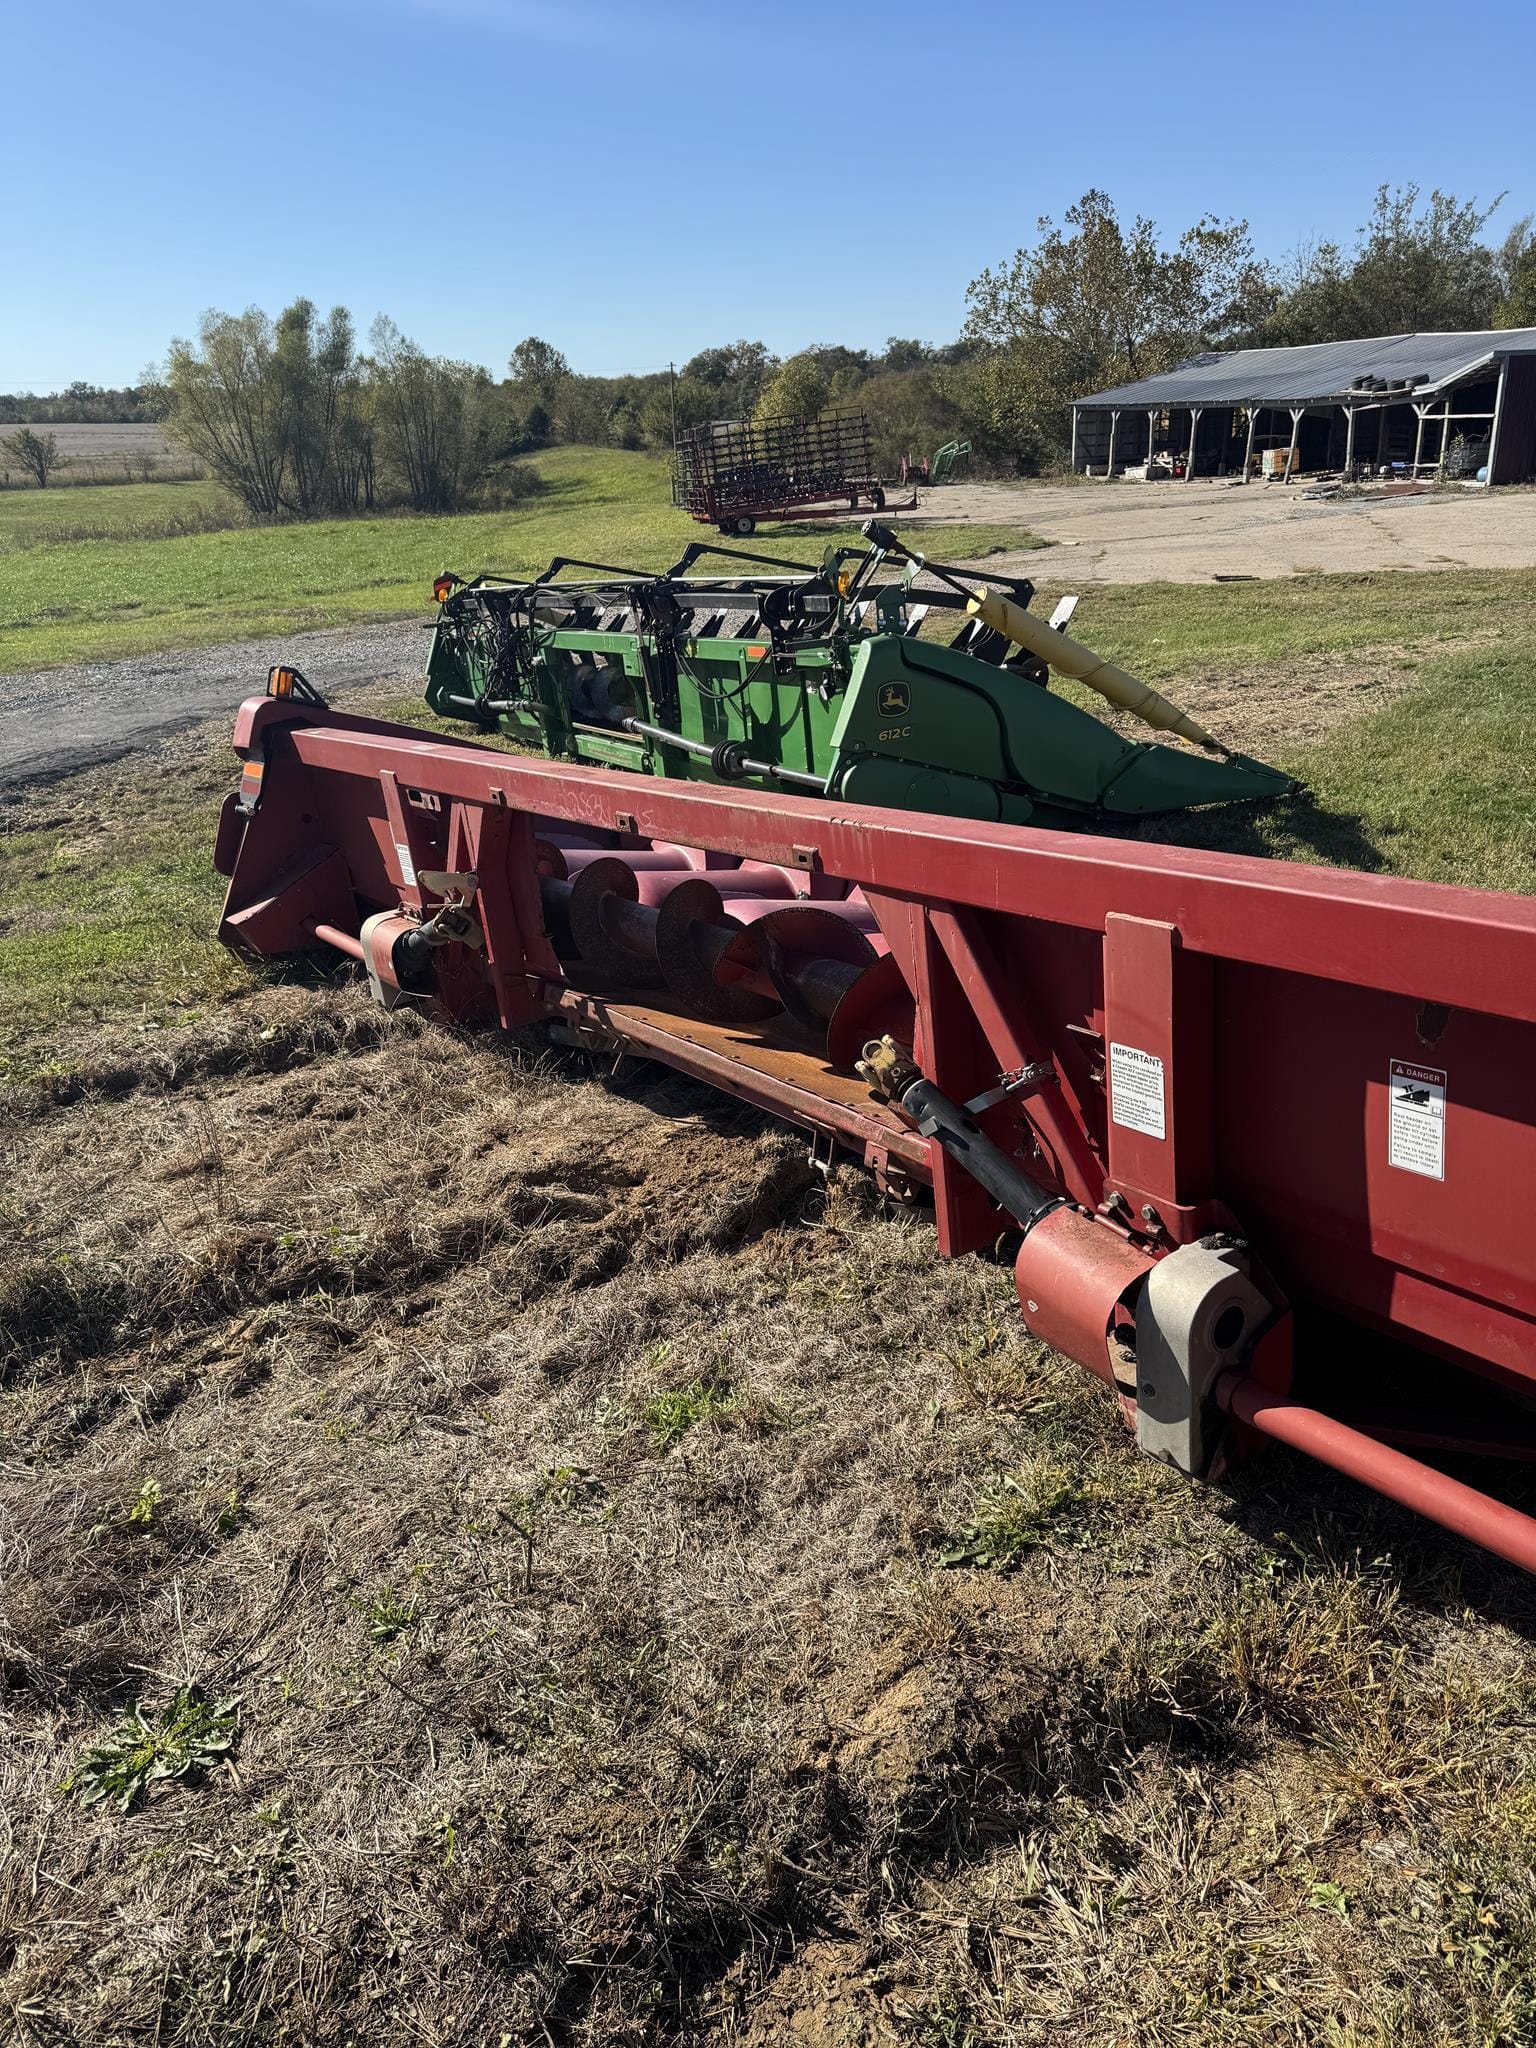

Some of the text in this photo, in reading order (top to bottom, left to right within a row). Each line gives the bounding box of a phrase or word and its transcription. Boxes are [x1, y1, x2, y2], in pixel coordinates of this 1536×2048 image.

[879, 726, 911, 741] 612C
[1113, 1047, 1160, 1067] IMPORTANT
[1407, 1069, 1440, 1082] DANGER
